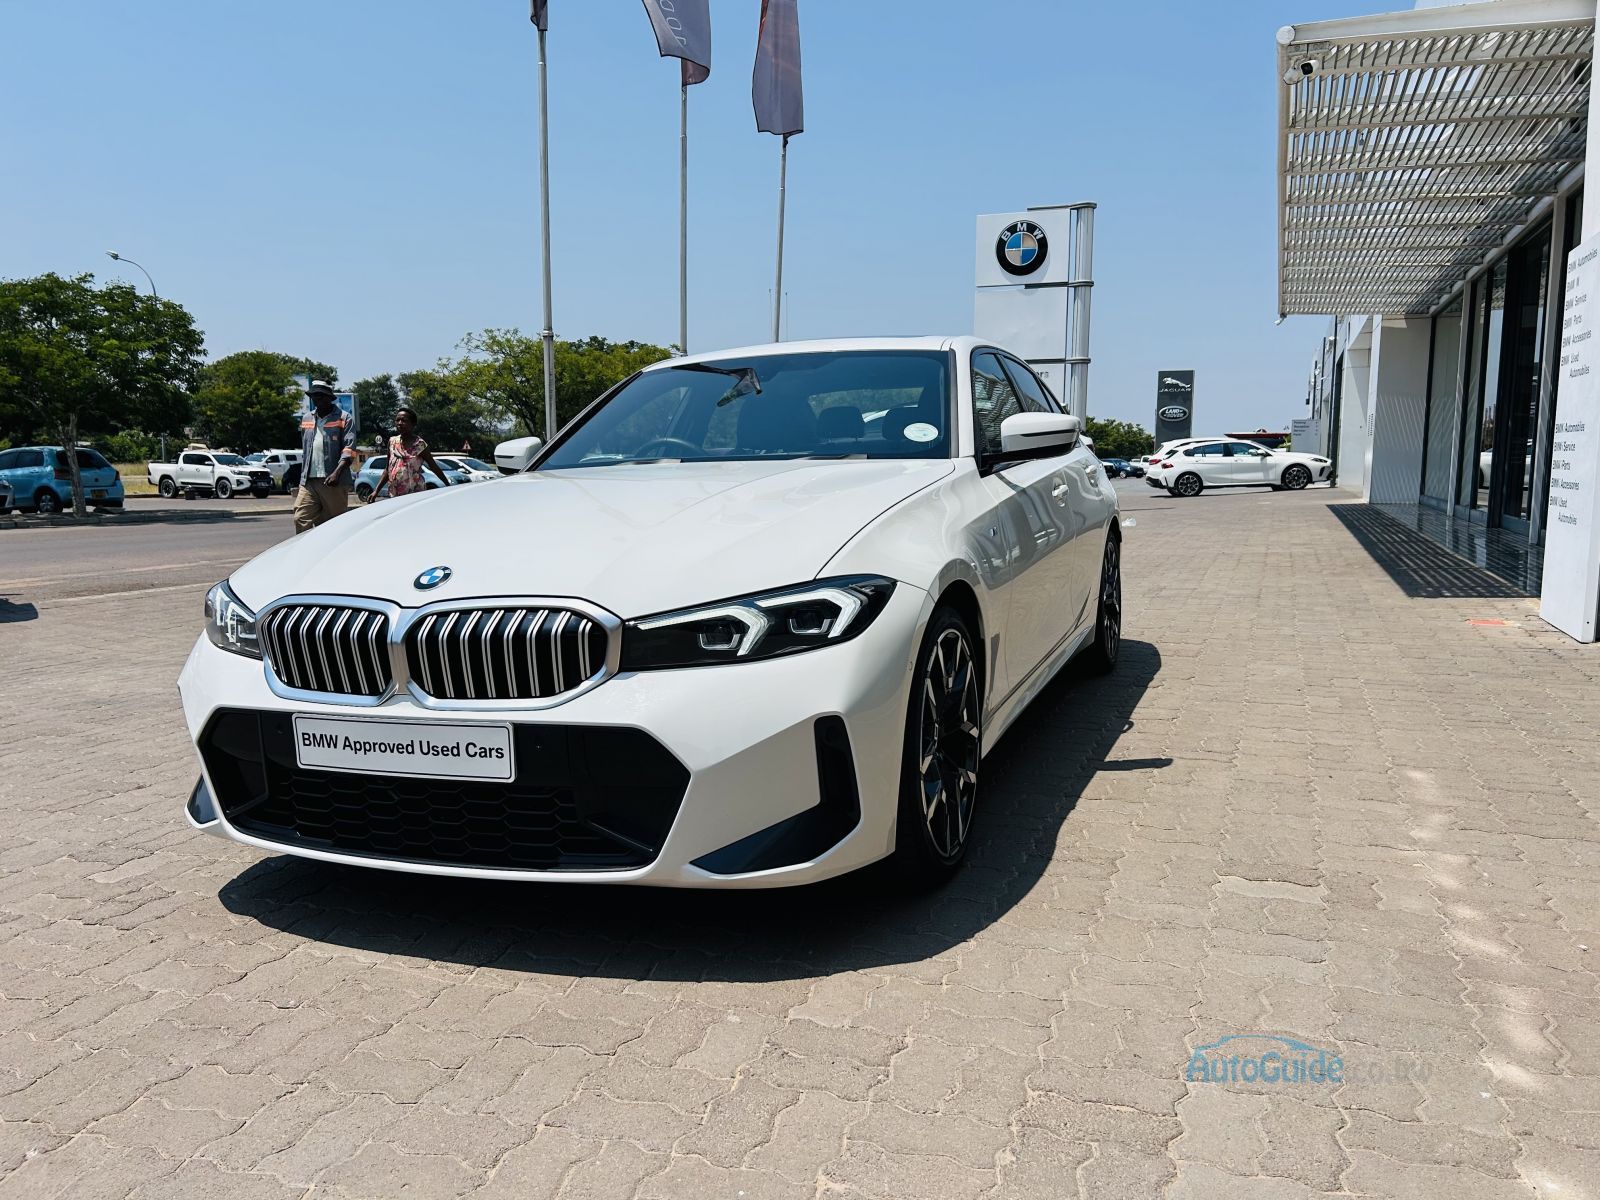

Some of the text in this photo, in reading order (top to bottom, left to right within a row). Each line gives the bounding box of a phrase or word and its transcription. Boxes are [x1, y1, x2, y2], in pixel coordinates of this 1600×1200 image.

[1001, 222, 1044, 242] BMW
[1577, 248, 1597, 268] Automobiles
[1572, 329, 1592, 344] Accessories
[1569, 364, 1590, 378] Automobiles
[1555, 421, 1585, 434] BMW Automobiles
[1554, 441, 1576, 452] BMW Service
[1561, 460, 1571, 470] Parts
[1561, 479, 1580, 491] Accessories
[1558, 512, 1577, 526] Automobiles
[301, 732, 504, 759] BMW Approved Used Cars
